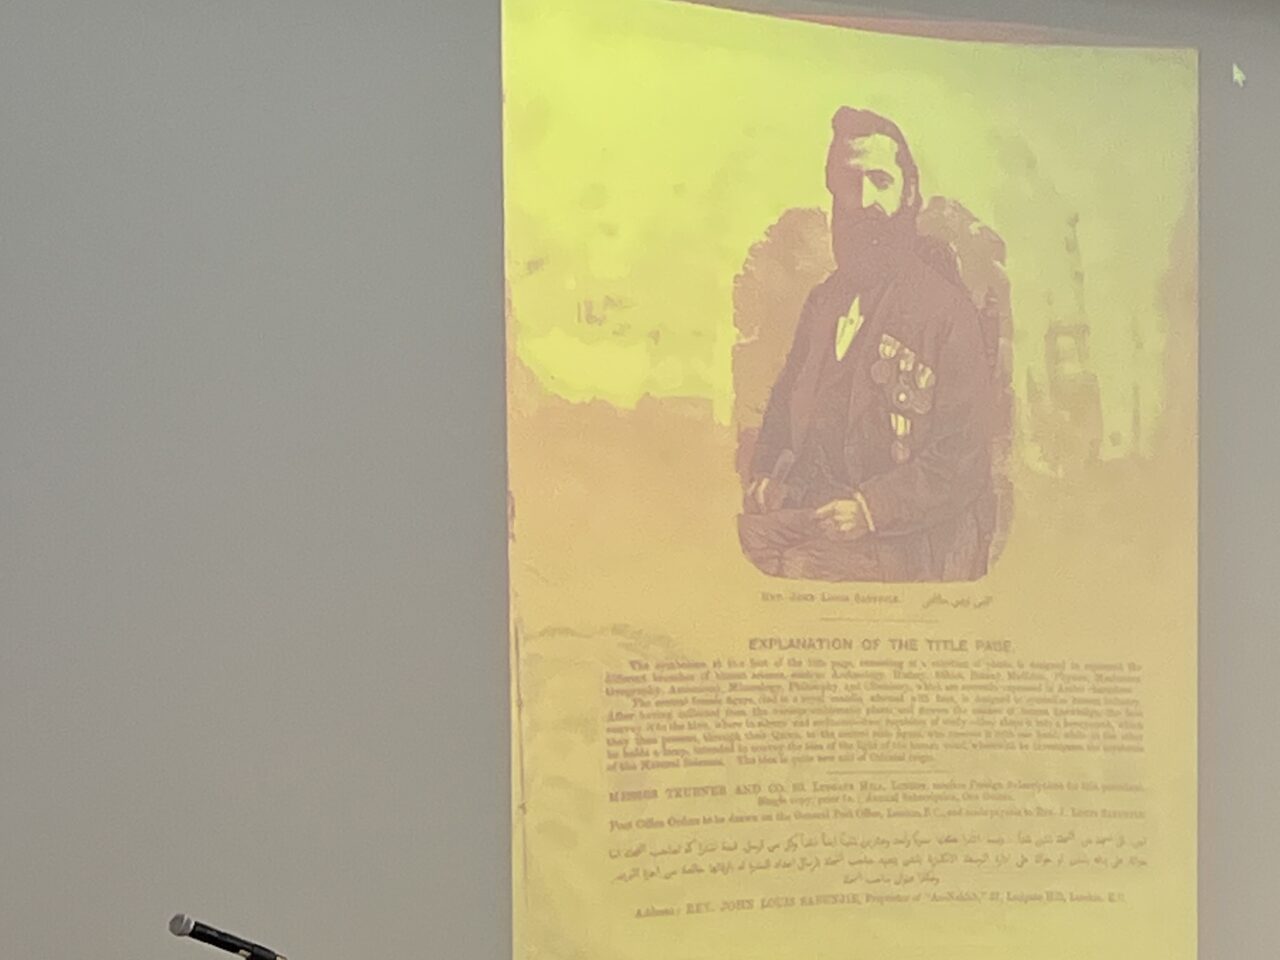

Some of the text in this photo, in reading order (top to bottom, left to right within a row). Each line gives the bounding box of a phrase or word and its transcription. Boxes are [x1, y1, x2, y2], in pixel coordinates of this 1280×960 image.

[749, 638, 853, 650] EXPLANATION
[861, 638, 880, 650] OF
[889, 638, 918, 651] THE
[928, 638, 968, 652] TITLE
[788, 659, 802, 667] the
[735, 784, 761, 794] AND
[776, 812, 790, 821] the
[720, 899, 753, 912] JOHN
[760, 896, 796, 908] LOUIS
